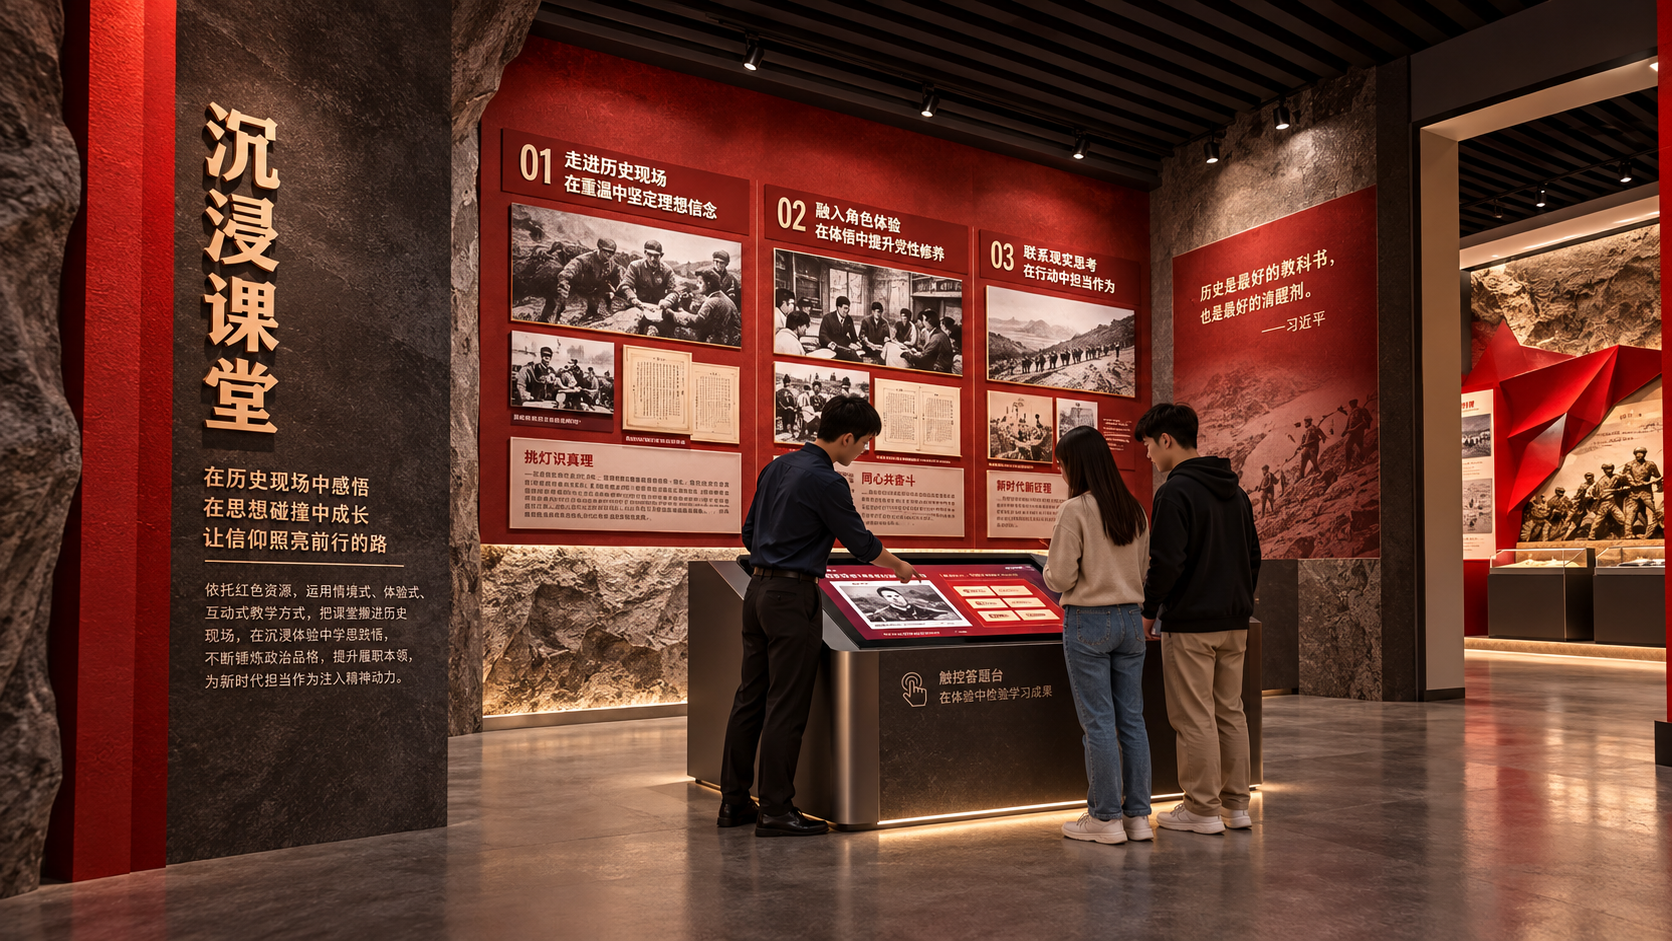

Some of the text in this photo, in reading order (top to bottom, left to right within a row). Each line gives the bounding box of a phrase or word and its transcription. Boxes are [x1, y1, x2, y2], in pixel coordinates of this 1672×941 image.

[519, 143, 551, 184] 01
[564, 150, 667, 188] 走进历史现场
[564, 174, 718, 220] 在重温中坚定理想信念
[777, 197, 806, 232] 02
[815, 201, 901, 233] 融入角色体验
[203, 101, 280, 434] 沉浸课堂
[991, 240, 1015, 271] 03
[1023, 244, 1097, 273] 联系现实思考
[1023, 263, 1115, 294] 在行动中担当作为
[524, 449, 594, 468] 挑灯识真理
[203, 465, 370, 498] 在历史现场中感悟
[203, 496, 370, 525] 在思想碰撞中成长
[203, 526, 388, 554] 让信仰照亮前行的路
[939, 669, 1004, 685] 触控答题台
[939, 685, 1053, 705] 在体验中检验学习成果
